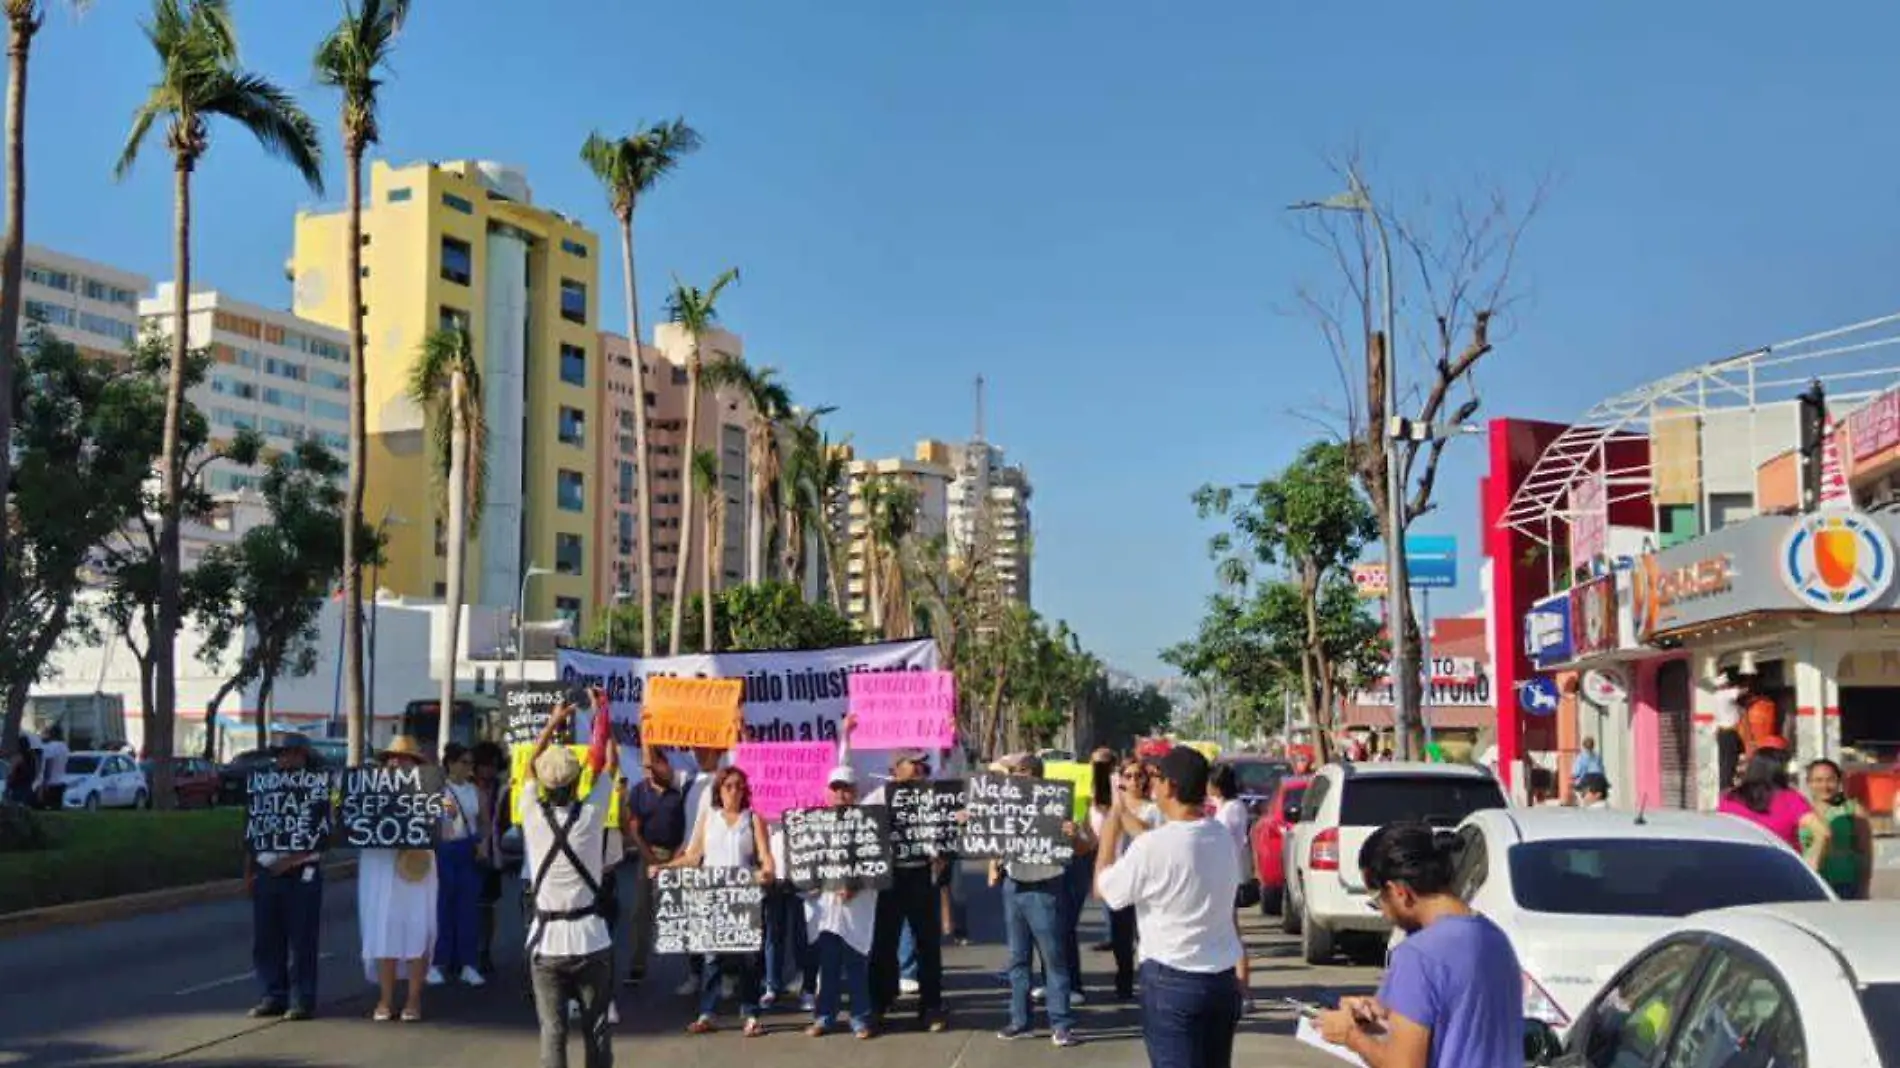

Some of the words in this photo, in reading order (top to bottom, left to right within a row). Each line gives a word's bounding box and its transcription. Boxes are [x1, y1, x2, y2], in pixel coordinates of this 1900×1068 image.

[347, 767, 422, 796] UNAM
[968, 775, 1022, 799] Nada
[1032, 784, 1070, 805] por
[1043, 801, 1066, 817] de
[272, 832, 321, 851] LEY
[658, 867, 752, 888] EJEMPLO
